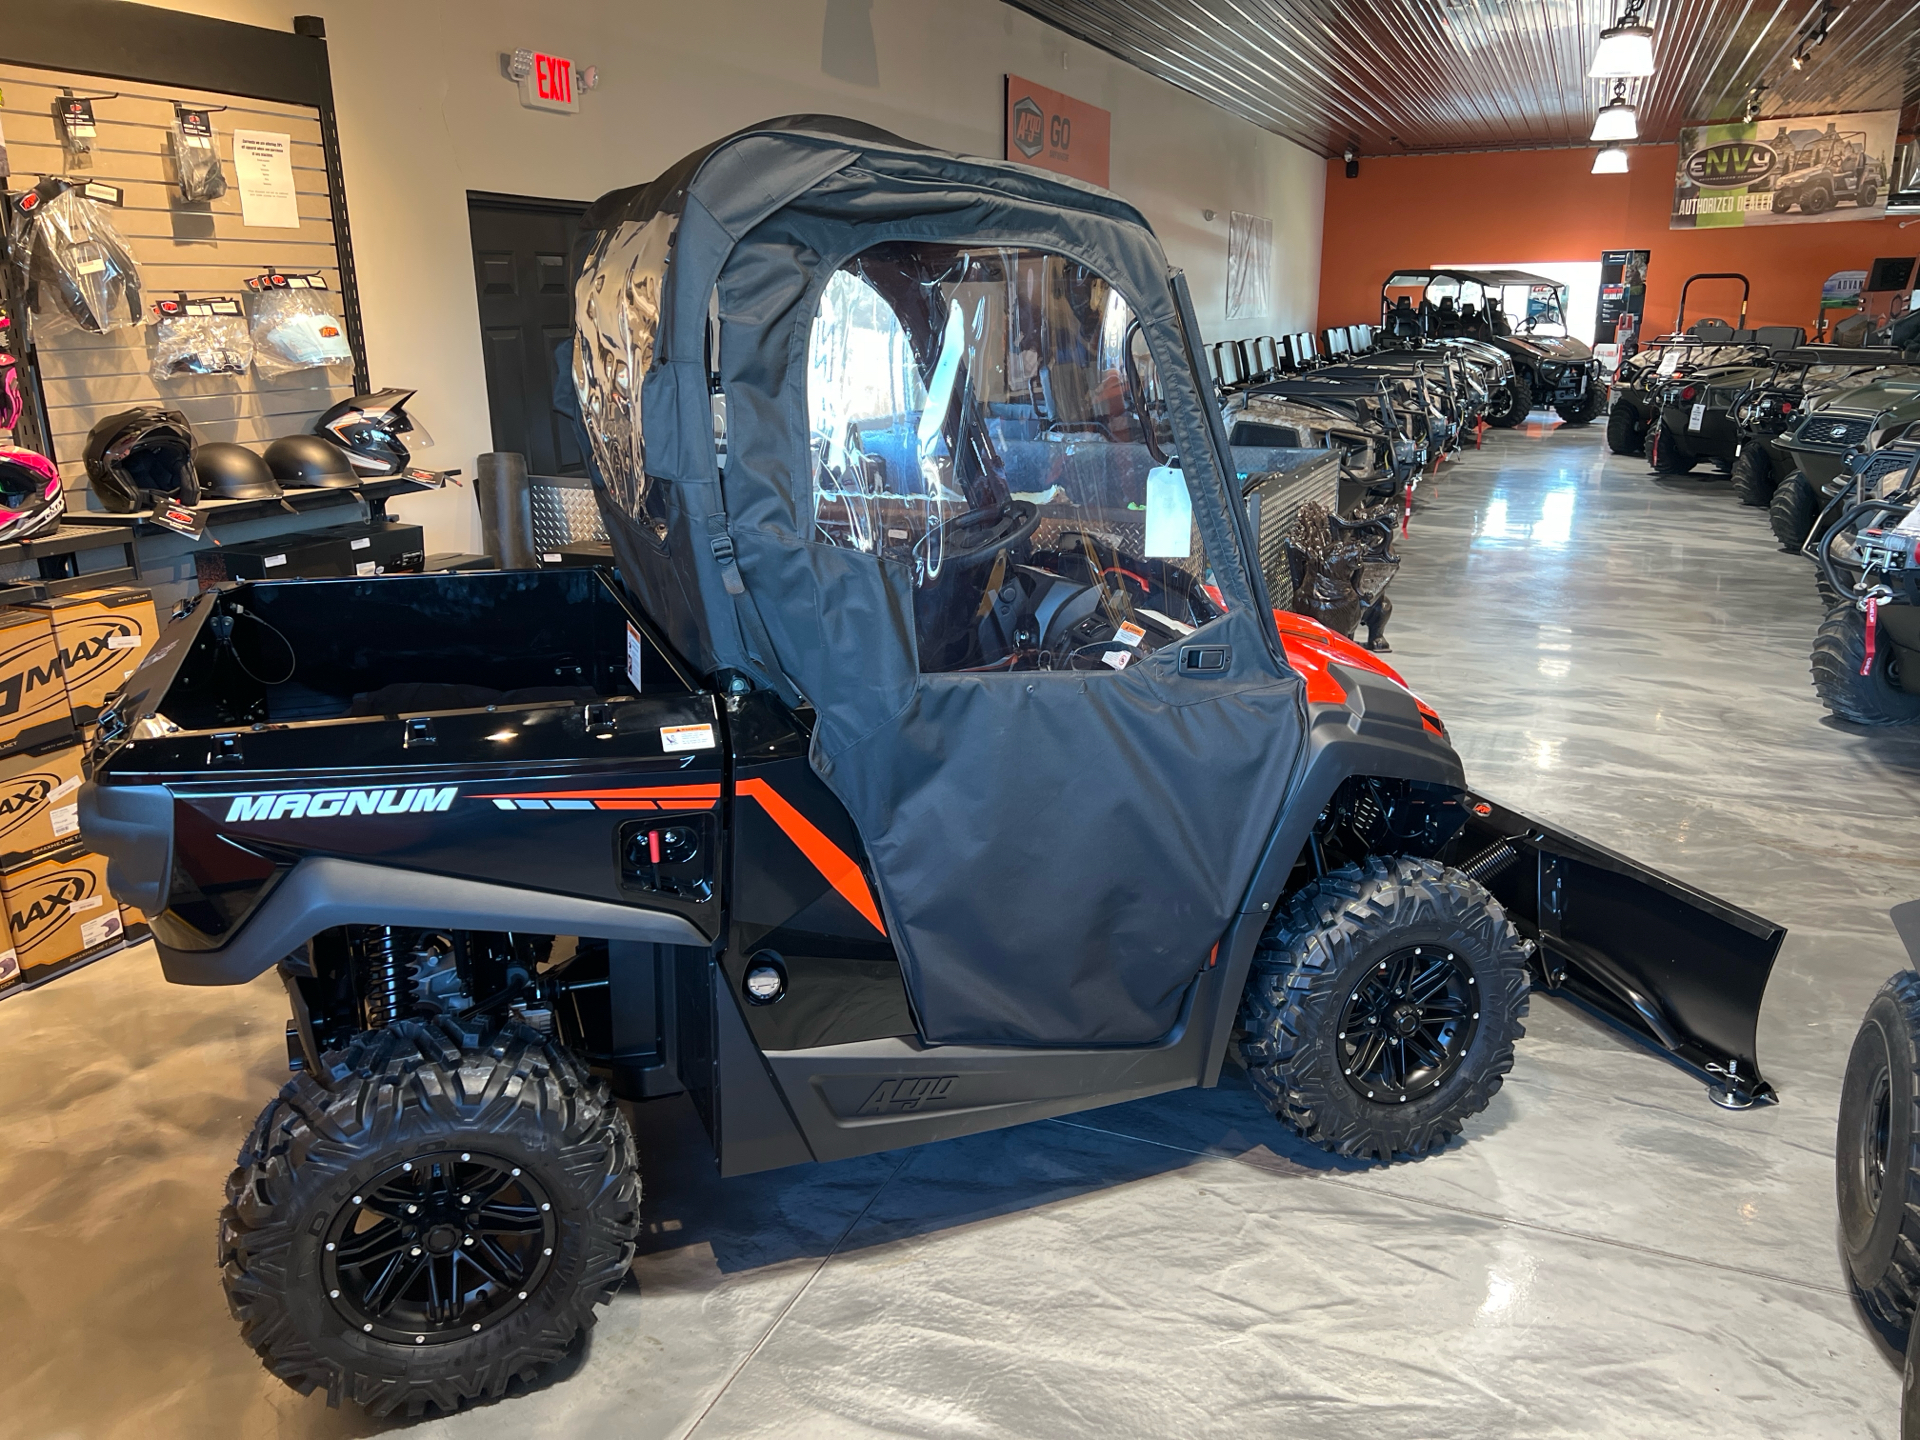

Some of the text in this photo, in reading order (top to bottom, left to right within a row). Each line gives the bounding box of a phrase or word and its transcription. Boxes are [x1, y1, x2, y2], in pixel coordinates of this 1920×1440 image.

[534, 53, 571, 104] EXIT
[1050, 114, 1071, 150] GO
[1678, 193, 1774, 216] AUTHORIZED DEALER
[225, 787, 458, 822] MAGNUM
